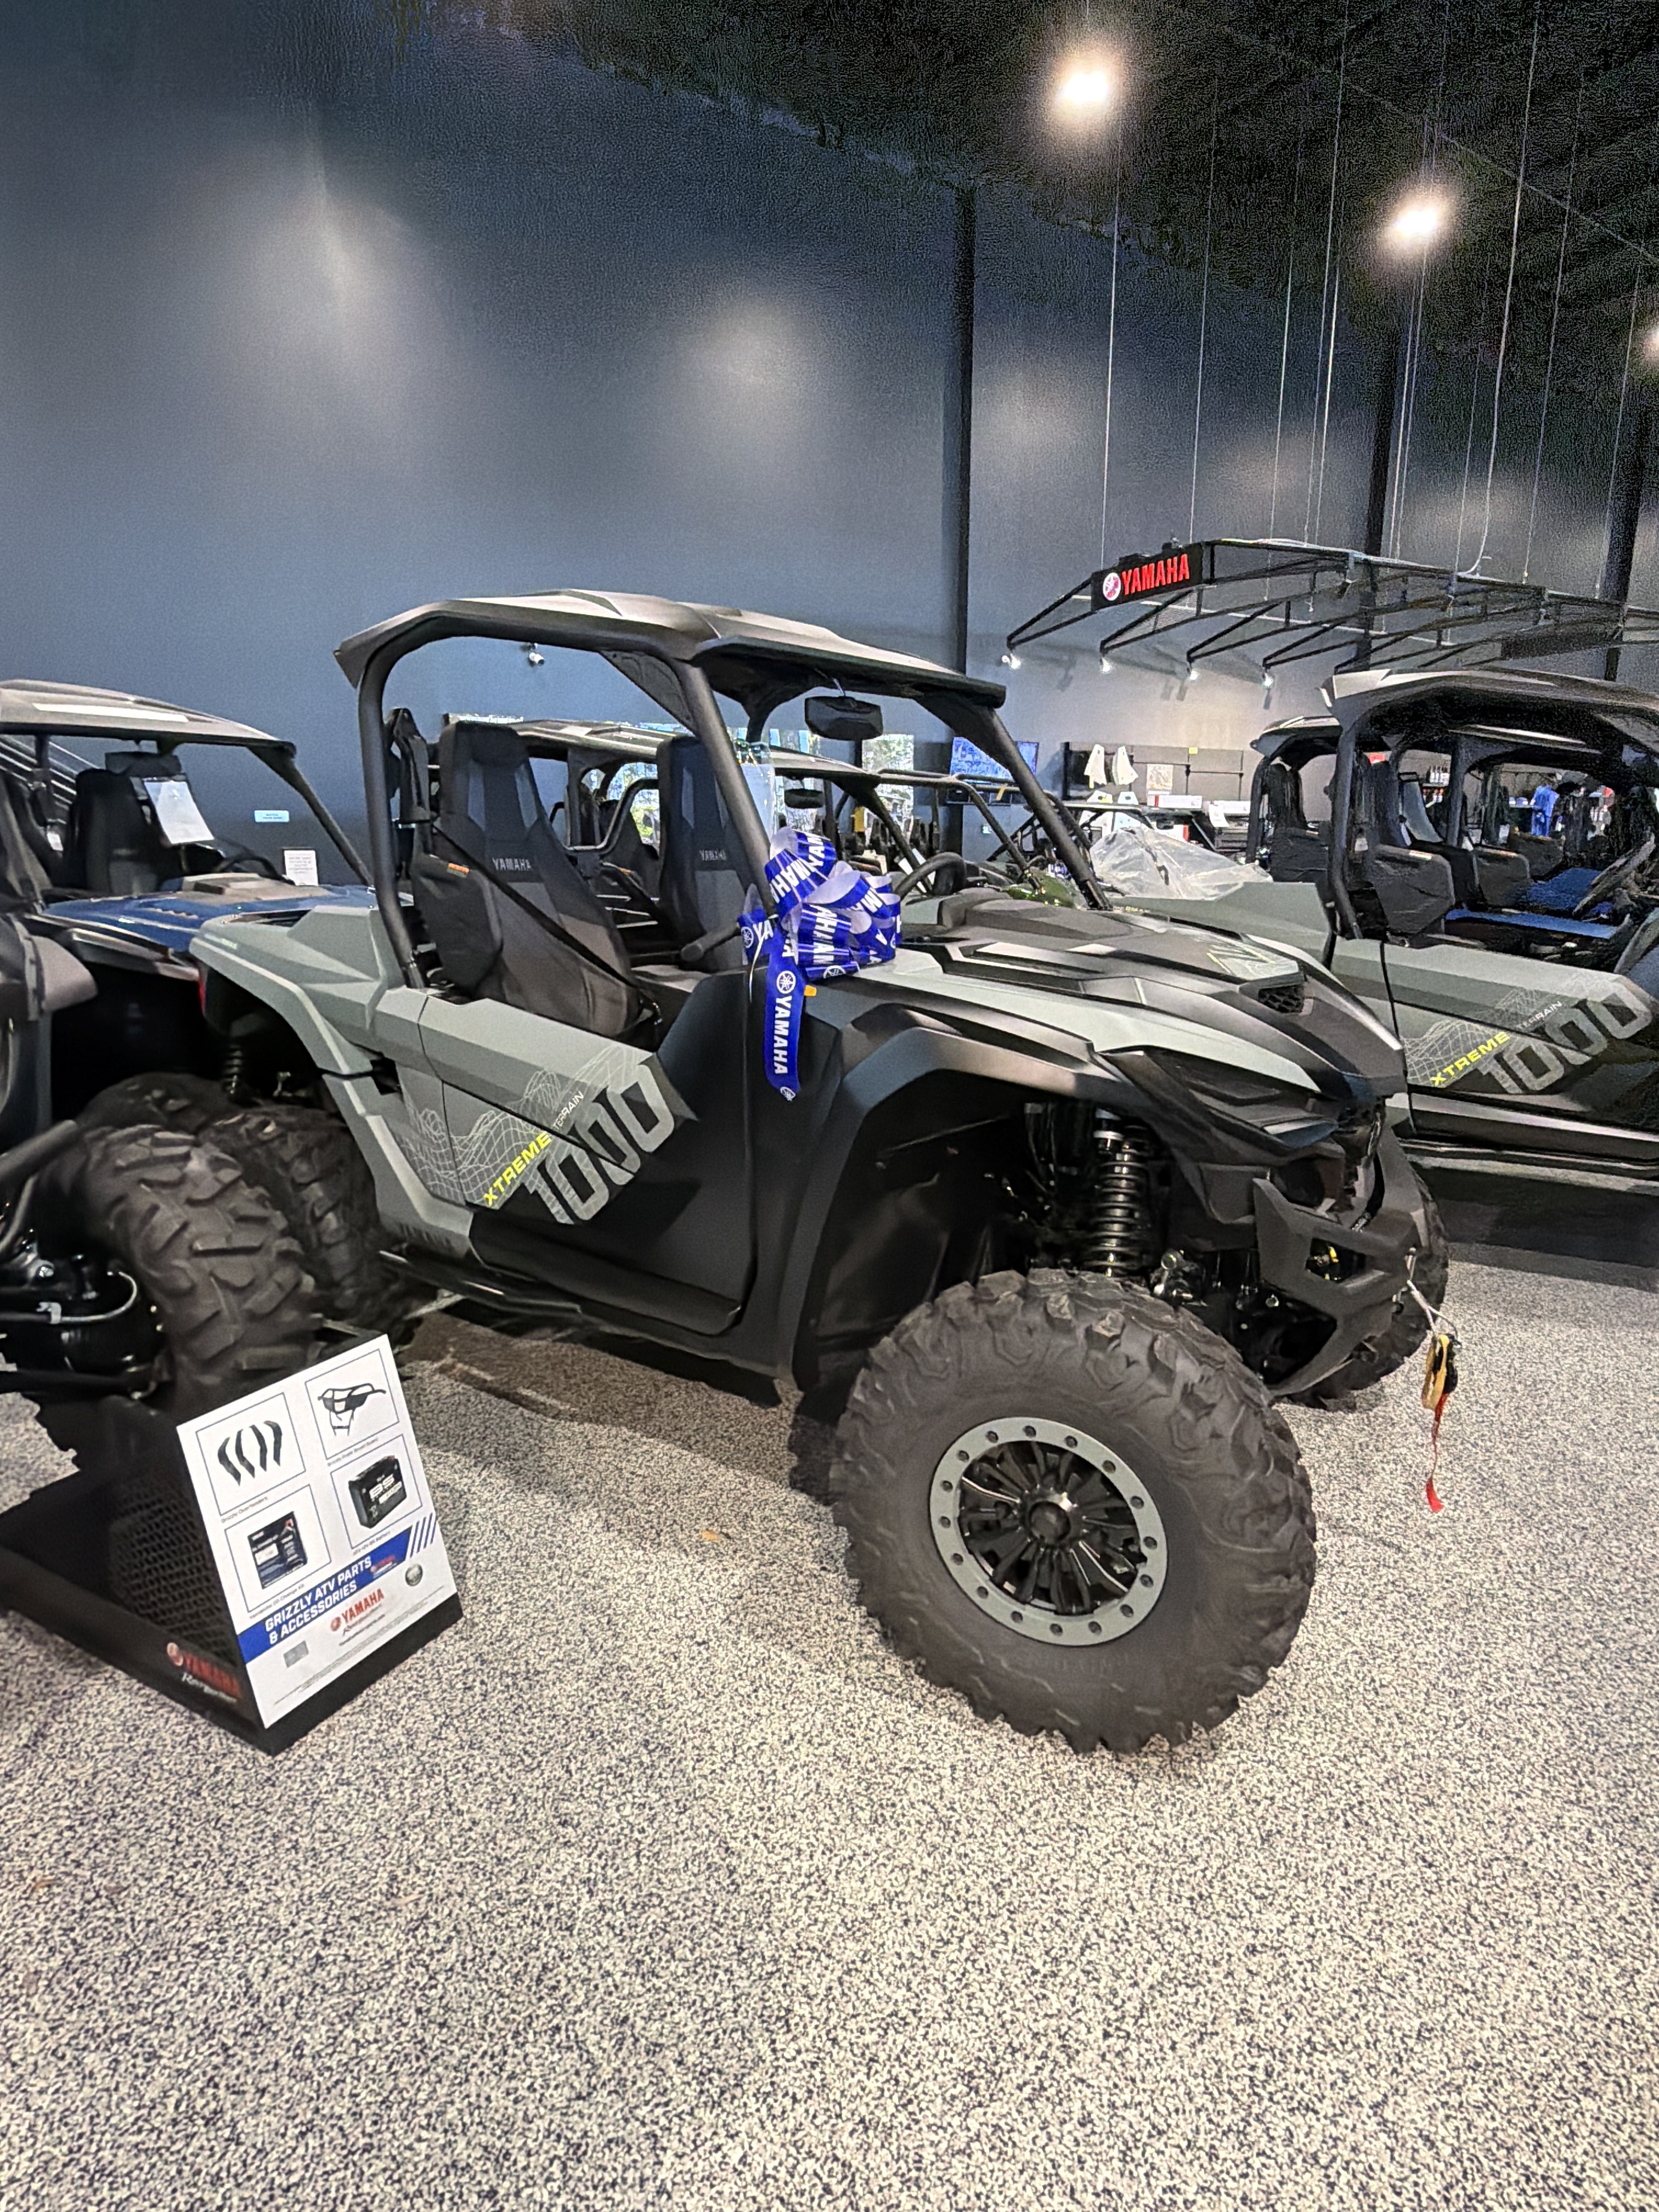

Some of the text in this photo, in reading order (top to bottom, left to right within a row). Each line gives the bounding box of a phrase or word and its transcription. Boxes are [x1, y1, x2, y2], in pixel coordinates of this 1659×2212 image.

[1121, 554, 1189, 596] YAMAHA
[492, 857, 531, 871] YAMAHA
[774, 995, 792, 1074] YAMAHA
[1430, 1000, 1562, 1087] XTREME TERRAIN
[1480, 981, 1652, 1094] 1000
[483, 1090, 585, 1207] XTREME TERRAIN
[524, 1064, 675, 1225] 1000
[265, 1591, 313, 1632] GRIZZLY
[315, 1577, 336, 1601] ATV
[338, 1556, 372, 1585] PARTS
[269, 1632, 278, 1645] &
[280, 1580, 357, 1638] ACCESSORIES
[341, 1589, 384, 1624] YAMAHA
